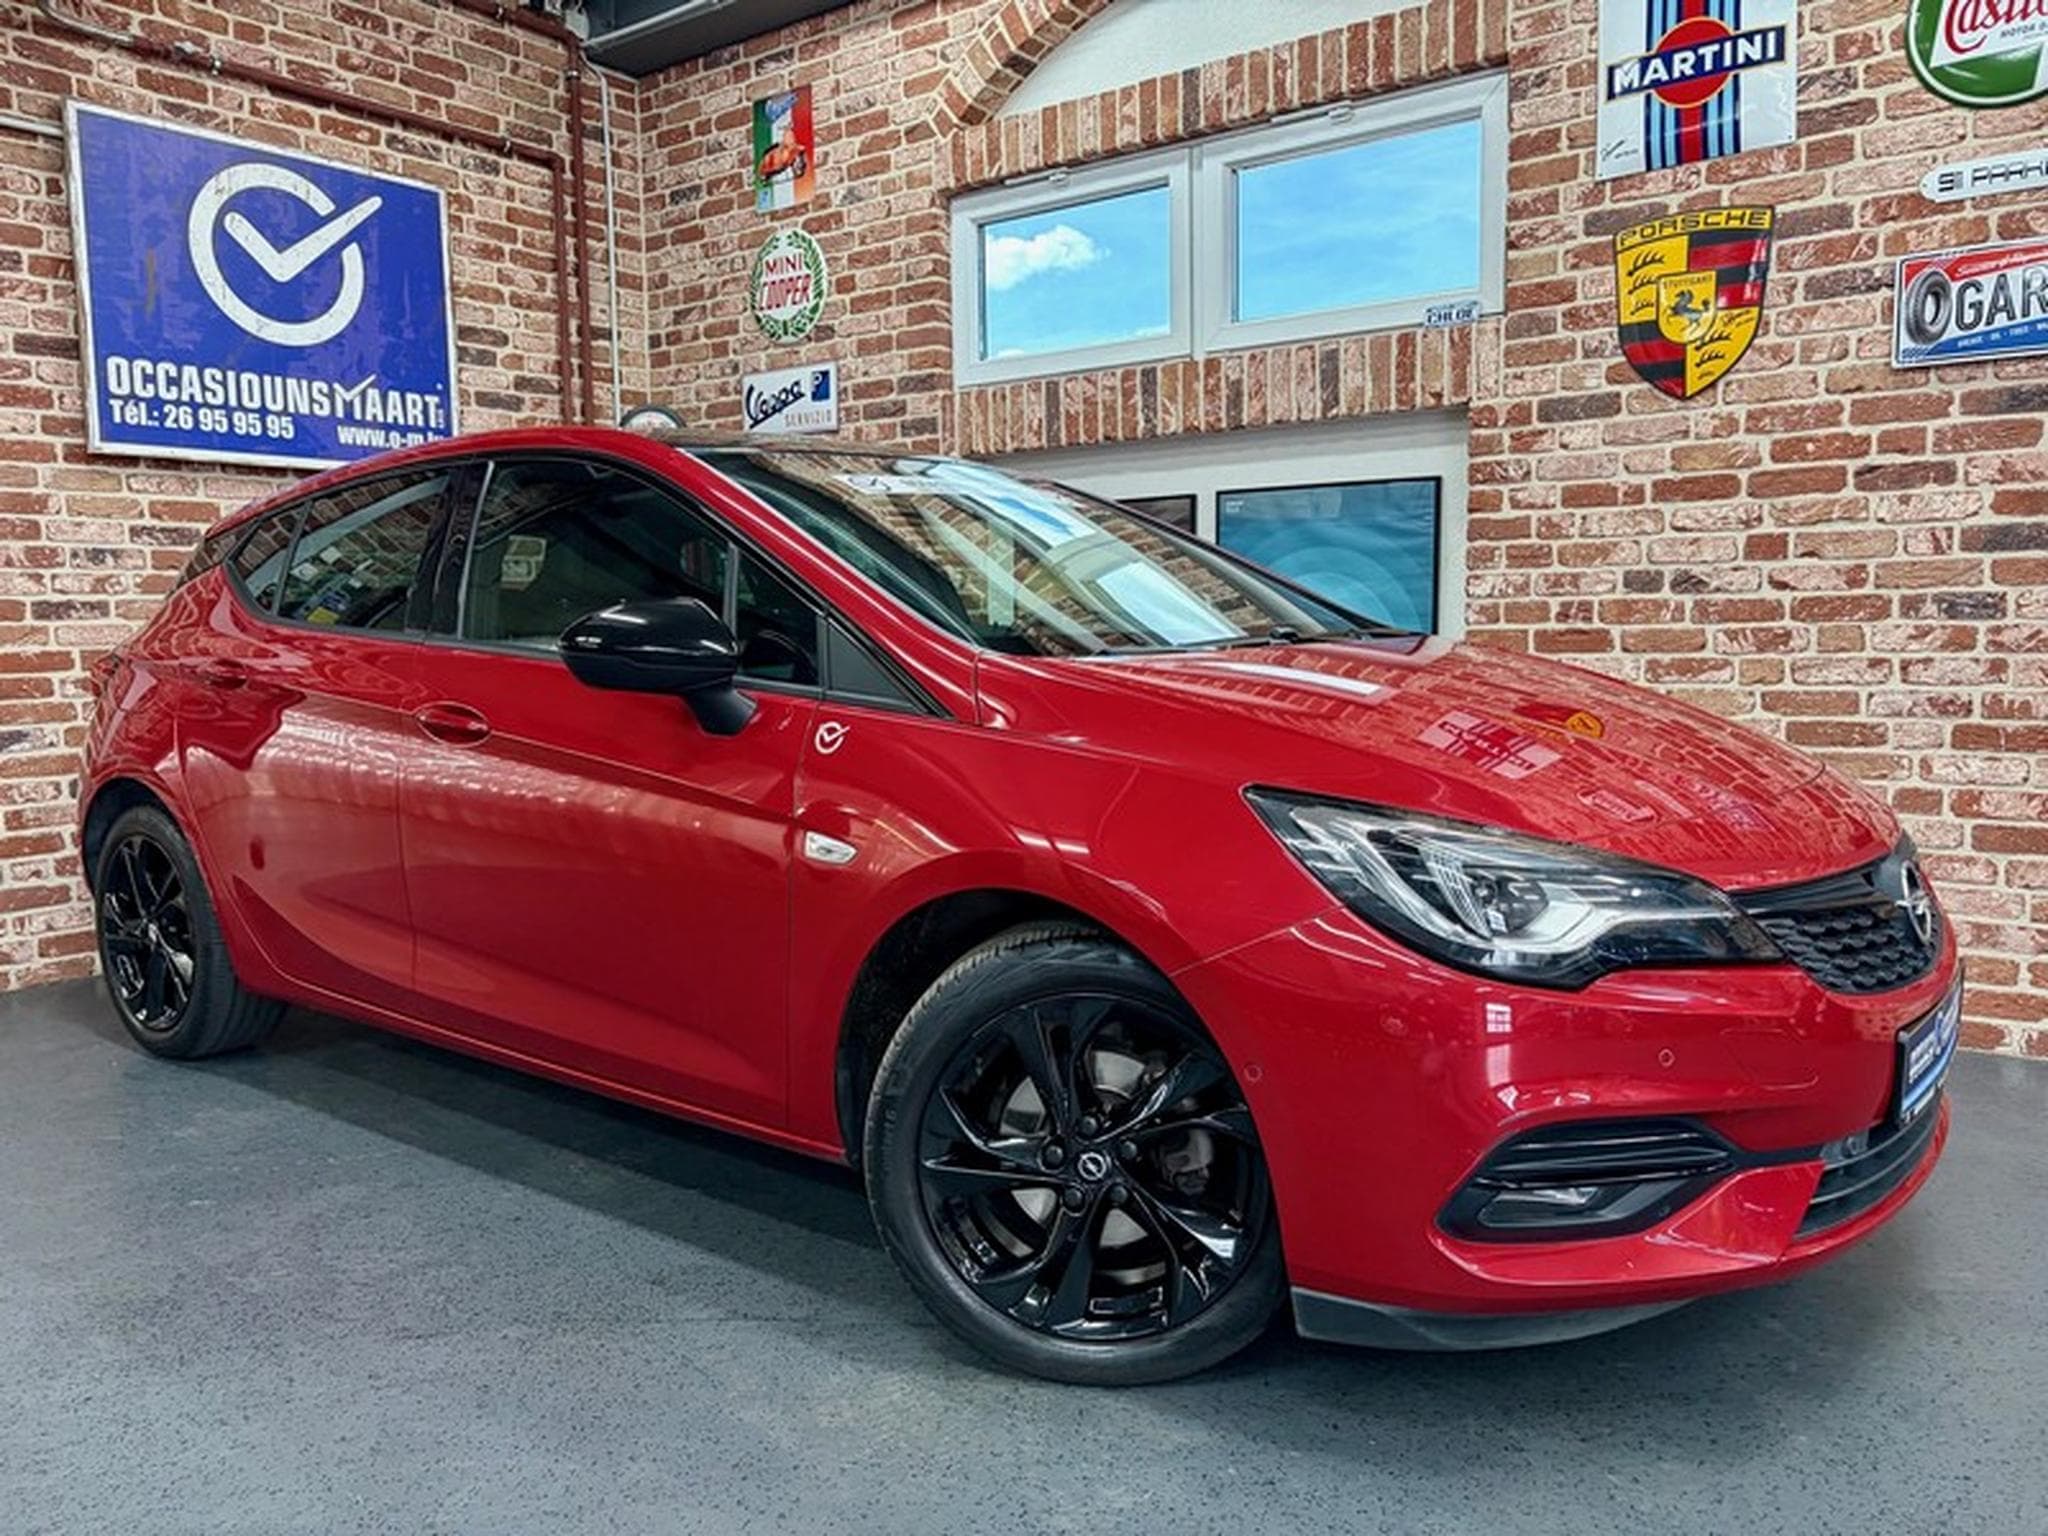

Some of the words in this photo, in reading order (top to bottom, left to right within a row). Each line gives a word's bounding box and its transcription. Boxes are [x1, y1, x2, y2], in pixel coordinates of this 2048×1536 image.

[1613, 31, 1776, 93] MARTINI
[1620, 210, 1767, 247] PORSCHE
[765, 253, 803, 275] MINI
[760, 274, 811, 310] COOPER
[106, 355, 440, 429] OCCASIOUNSMAART
[745, 380, 806, 430] Vespa
[163, 404, 194, 430] 26
[198, 407, 228, 433] 95
[232, 410, 262, 436] 95
[265, 414, 295, 440] 95
